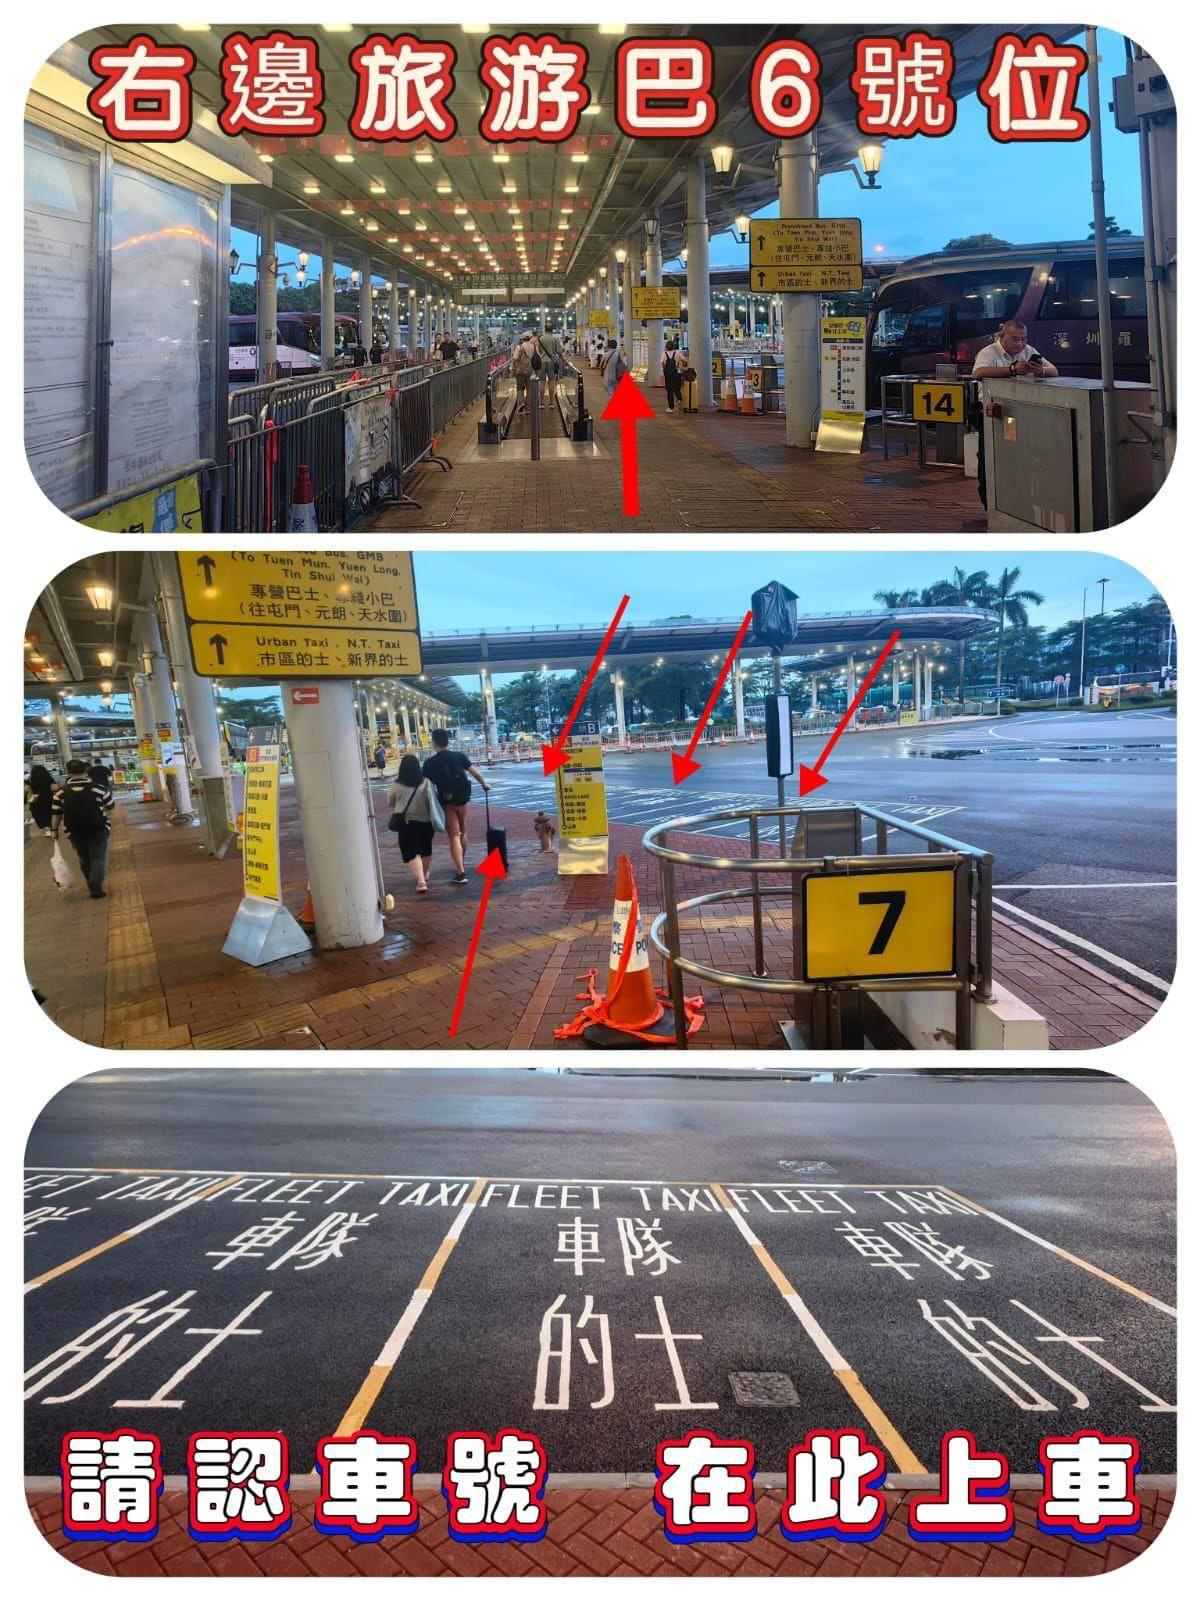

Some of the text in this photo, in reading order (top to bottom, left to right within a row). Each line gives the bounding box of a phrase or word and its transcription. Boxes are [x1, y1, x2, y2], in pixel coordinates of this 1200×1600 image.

[921, 391, 955, 417] 14
[231, 551, 255, 562] (To
[263, 553, 294, 565] Tuen
[338, 560, 367, 573] Yuen
[357, 551, 385, 561] GMB
[282, 568, 302, 579] Tin
[309, 570, 336, 581] Shui
[256, 636, 401, 650] Urban Taxi N.T. Taxi
[259, 652, 410, 668] 市區的士、新界的士
[270, 728, 278, 743] A
[858, 890, 906, 955] 7
[24, 1174, 226, 1201] EET TAXI
[203, 1176, 470, 1207] FLEET TAXI
[482, 1183, 728, 1212] FLEET TAXI
[728, 1186, 980, 1216] FLEET TAXI
[204, 1210, 379, 1273] 車隊
[553, 1216, 683, 1276] 車隊
[834, 1220, 994, 1282] 車隊
[24, 1289, 274, 1410] 的士
[532, 1294, 719, 1412] 的士
[916, 1298, 1178, 1414] 的士
